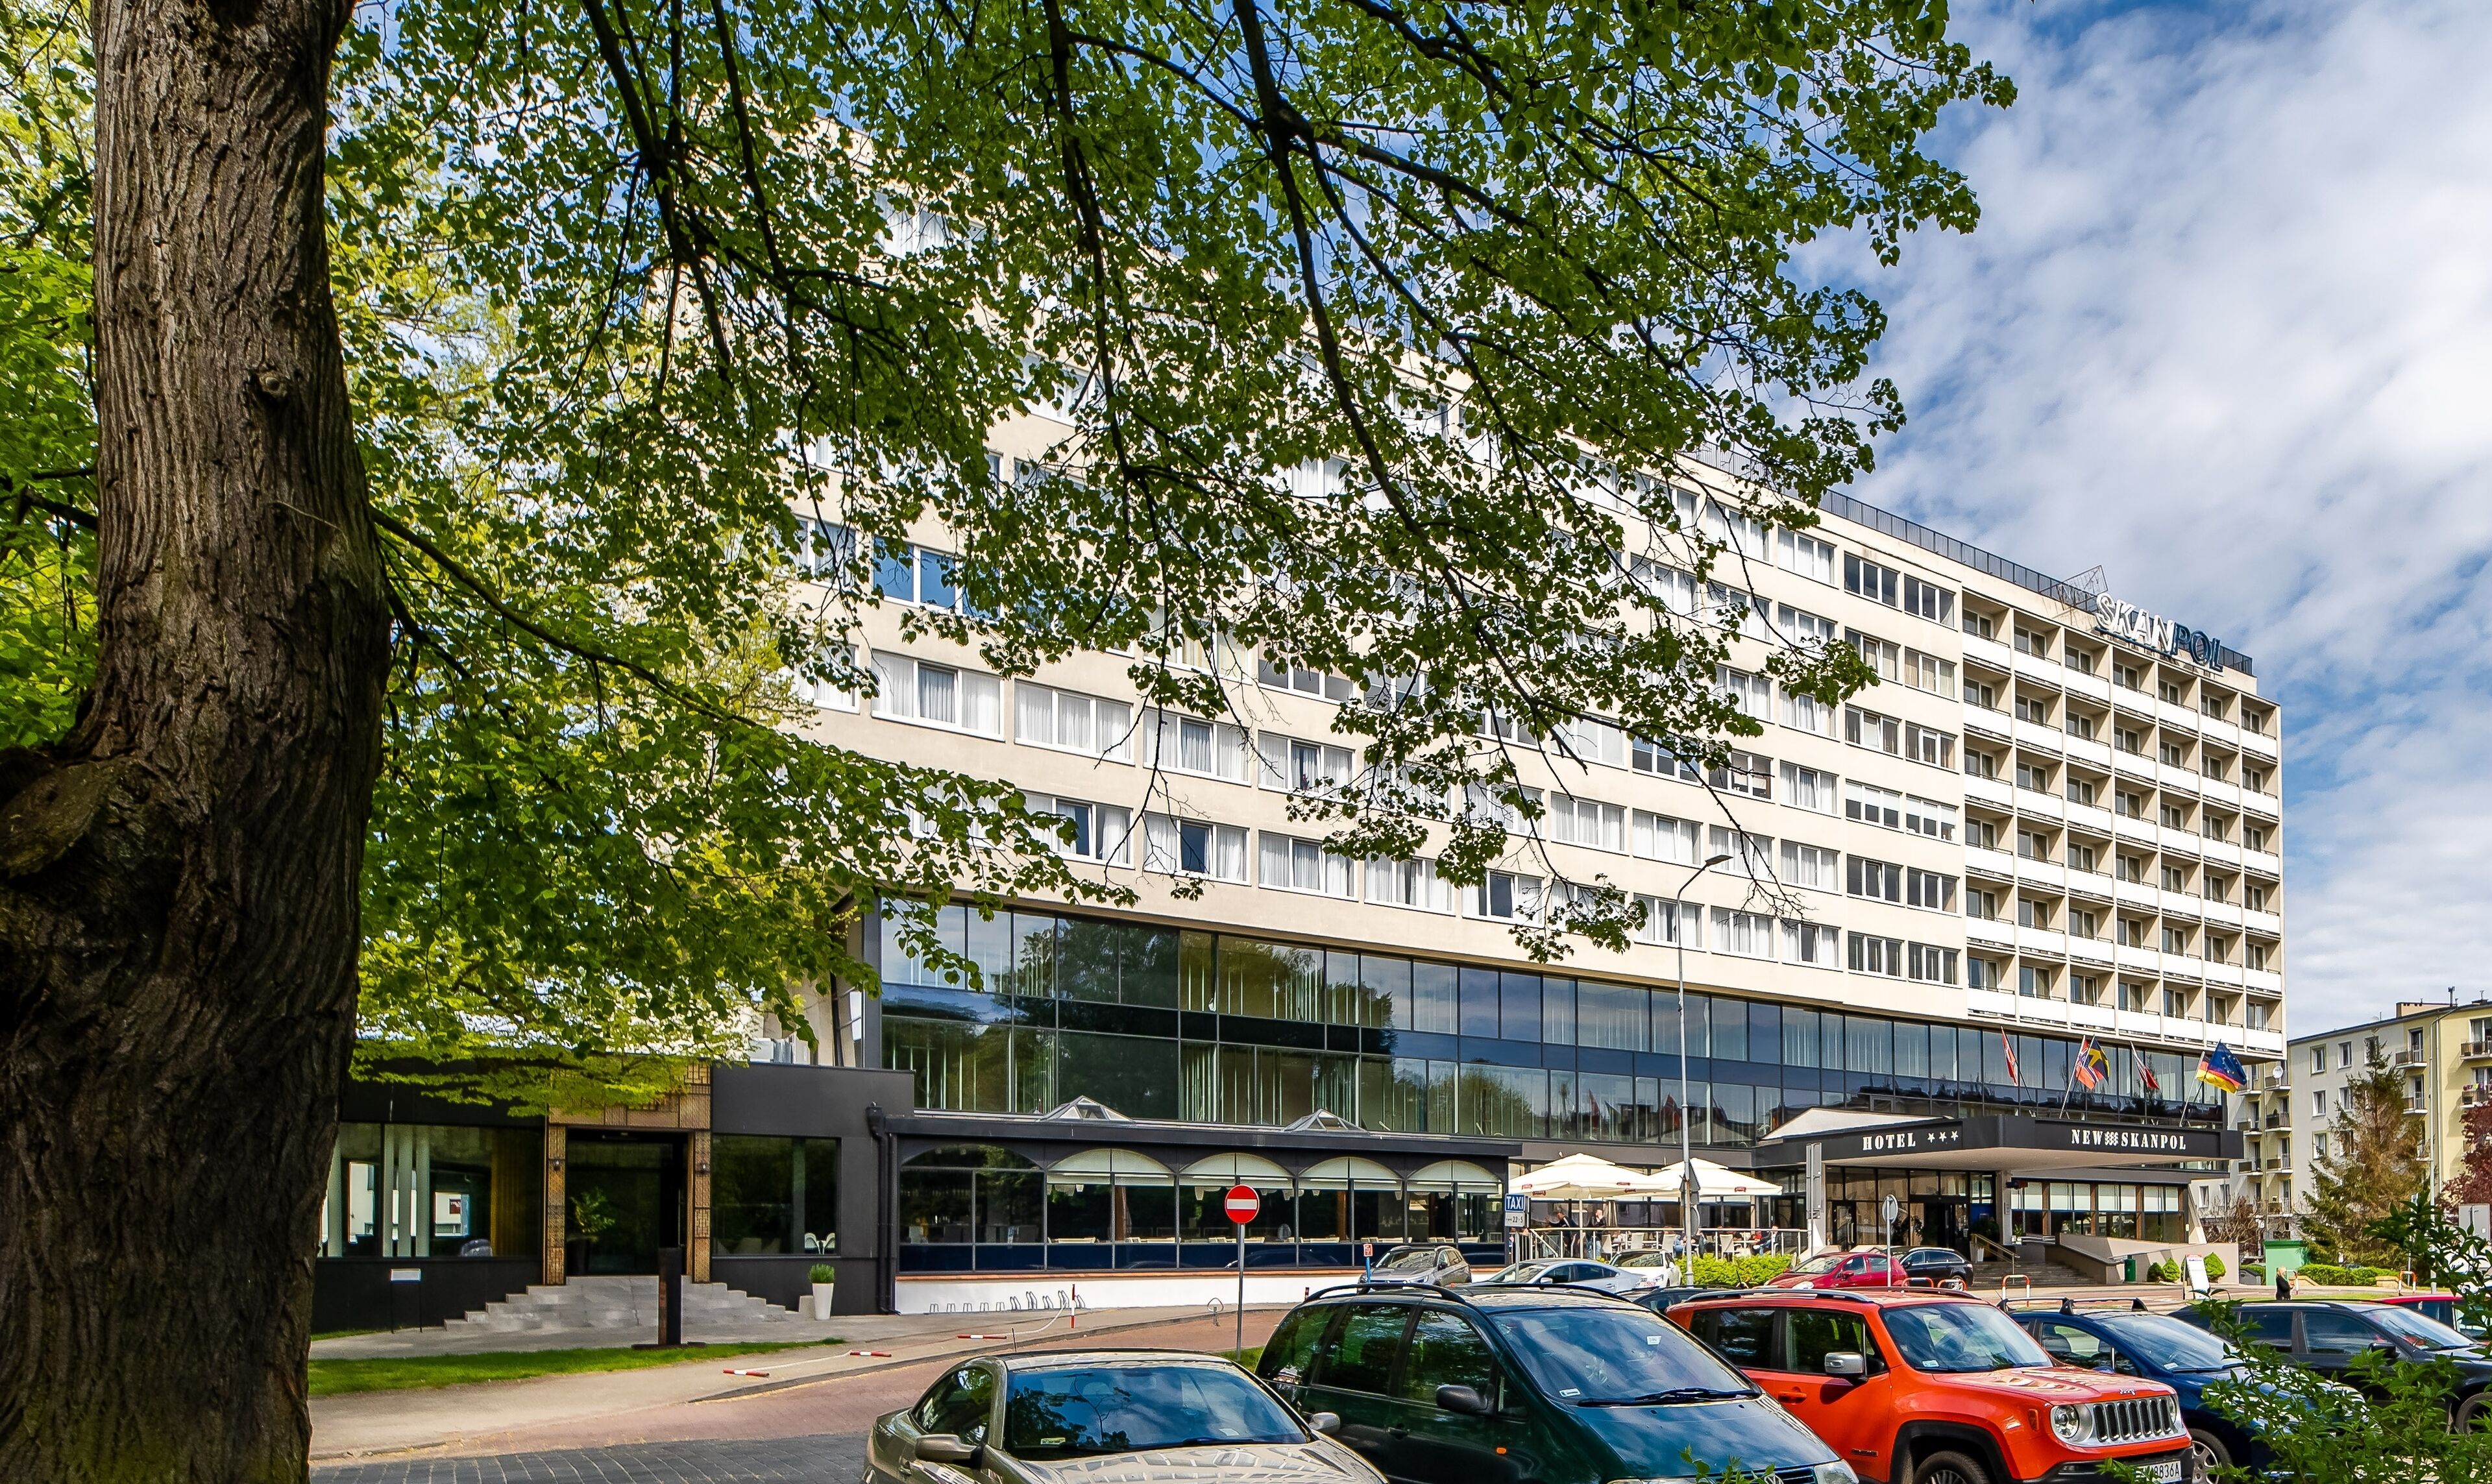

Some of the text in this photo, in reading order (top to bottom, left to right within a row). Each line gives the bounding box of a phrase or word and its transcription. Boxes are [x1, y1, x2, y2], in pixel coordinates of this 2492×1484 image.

[2095, 592, 2223, 673] SKANPOL
[1863, 1132, 1916, 1150] HOTEL
[2071, 1129, 2186, 1150] NEW SKANPOL
[1506, 1196, 1524, 1210] TAXI
